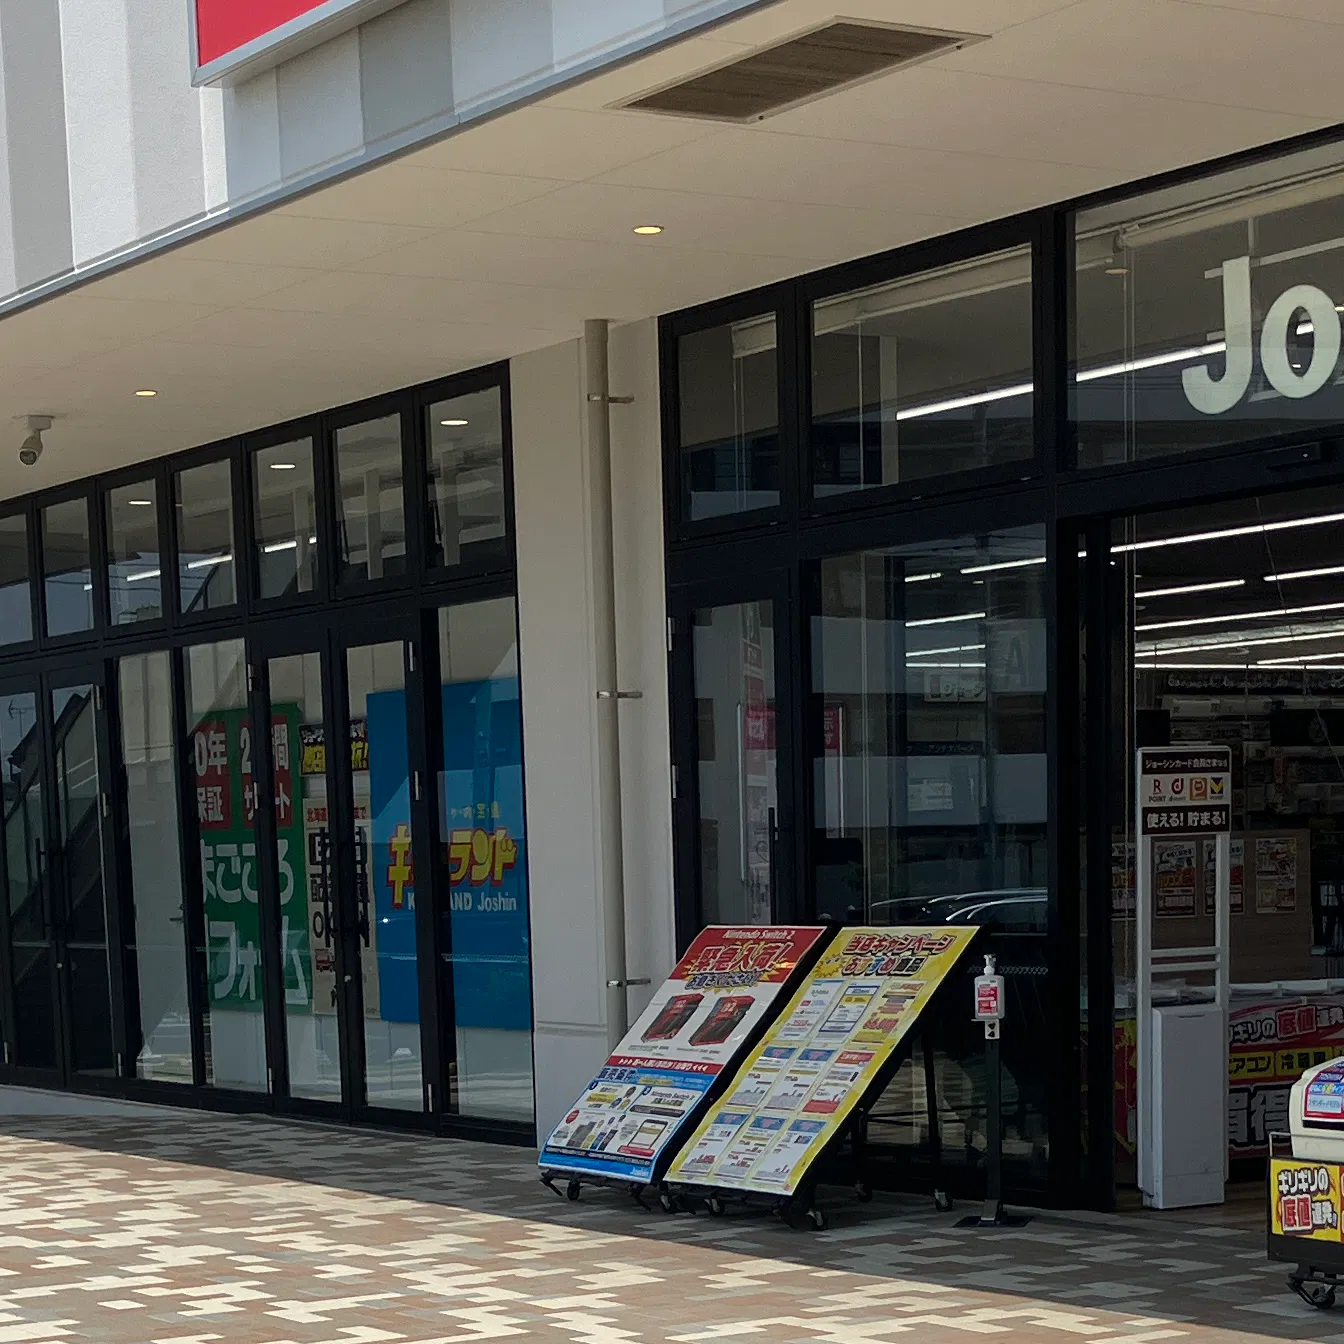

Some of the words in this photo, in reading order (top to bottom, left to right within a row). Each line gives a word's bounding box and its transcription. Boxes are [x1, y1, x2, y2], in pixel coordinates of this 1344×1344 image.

[478, 891, 516, 911] Joshin
[722, 930, 759, 938] Nintendo
[759, 929, 787, 939] Switch
[843, 933, 957, 955] 当店キャンペーン
[1278, 1167, 1329, 1194] ギリギリの
